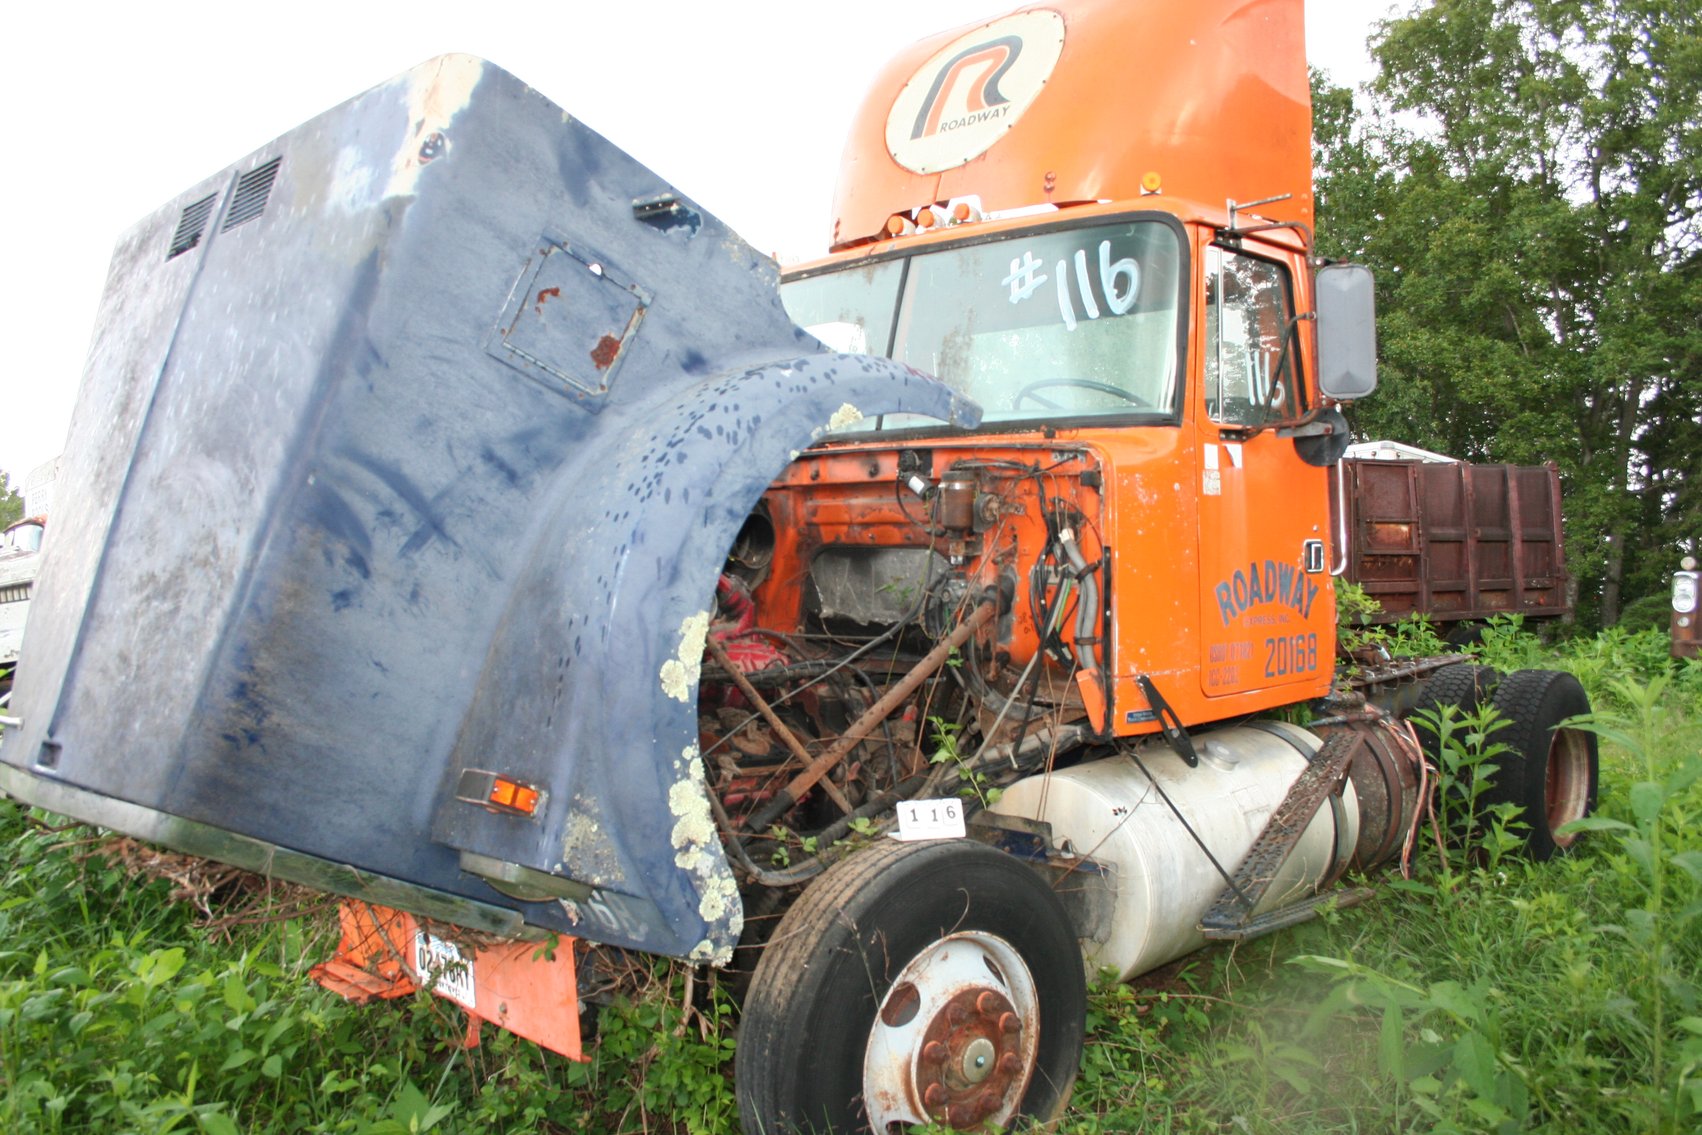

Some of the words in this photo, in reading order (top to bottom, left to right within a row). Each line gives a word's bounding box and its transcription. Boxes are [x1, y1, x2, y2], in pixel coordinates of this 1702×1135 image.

[940, 105, 1011, 133] ROADWAY
[1001, 240, 1140, 331] #116
[1215, 559, 1319, 627] ROADWAY
[1265, 632, 1317, 678] 20168
